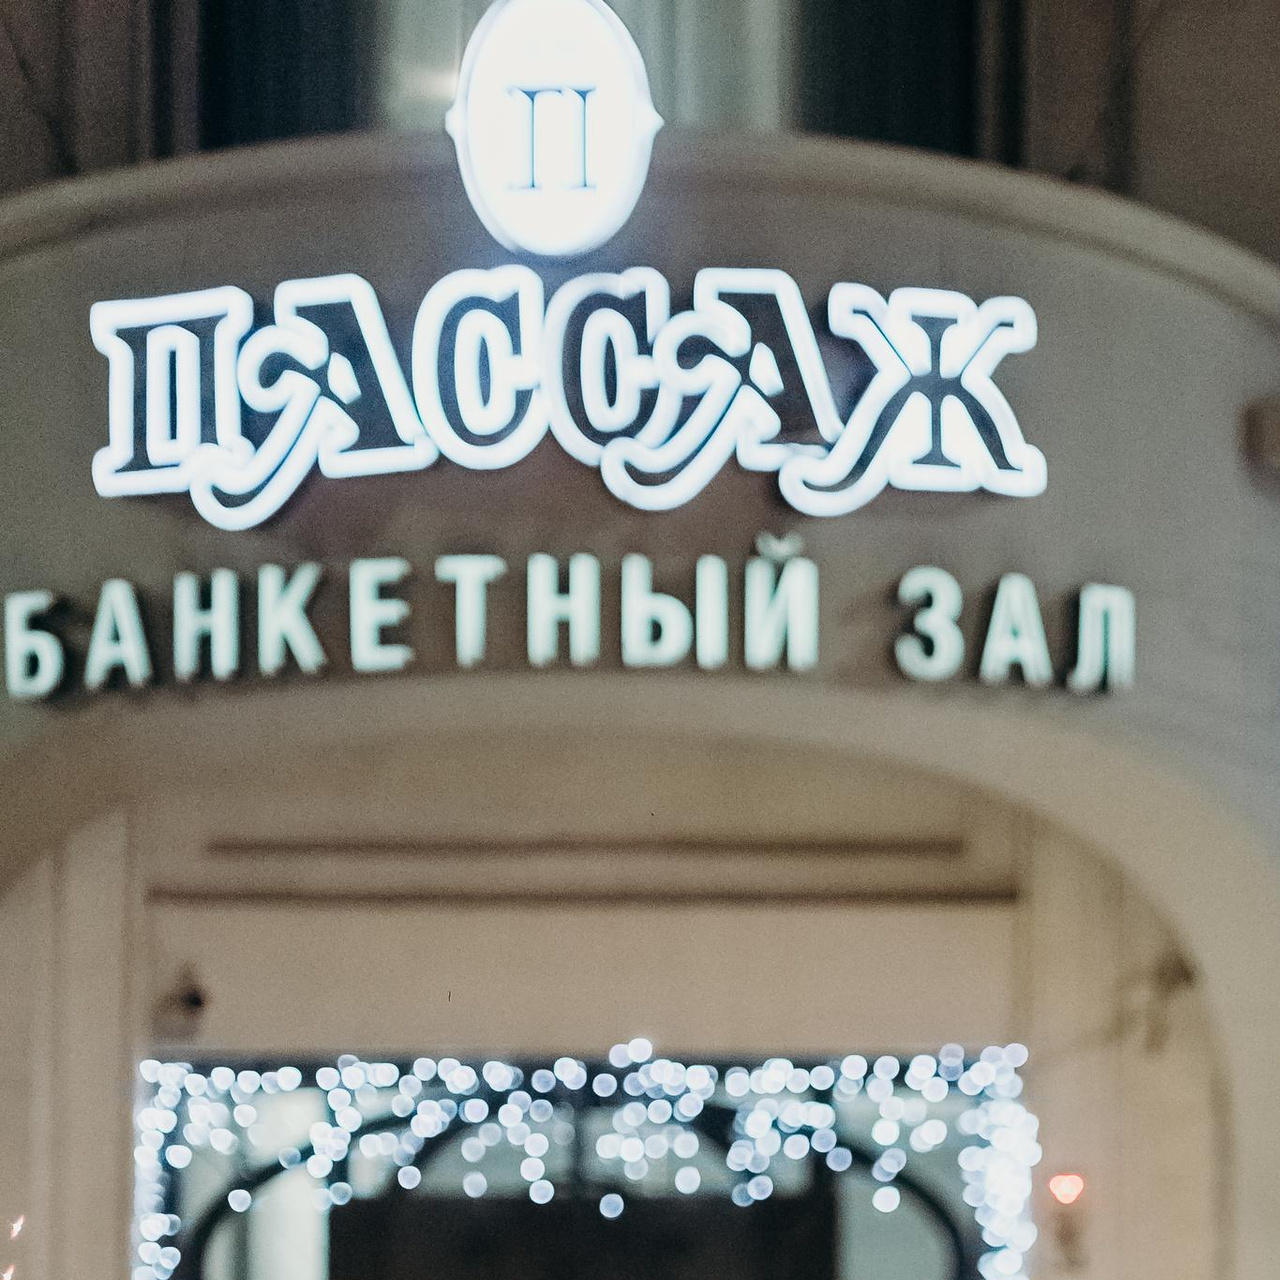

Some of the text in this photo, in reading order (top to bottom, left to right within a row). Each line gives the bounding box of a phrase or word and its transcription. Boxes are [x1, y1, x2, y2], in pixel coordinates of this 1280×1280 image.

[90, 265, 1047, 531] ПАССАЖ
[3, 531, 1138, 699] БАНКЕТНЫЙ ЗАЛ
